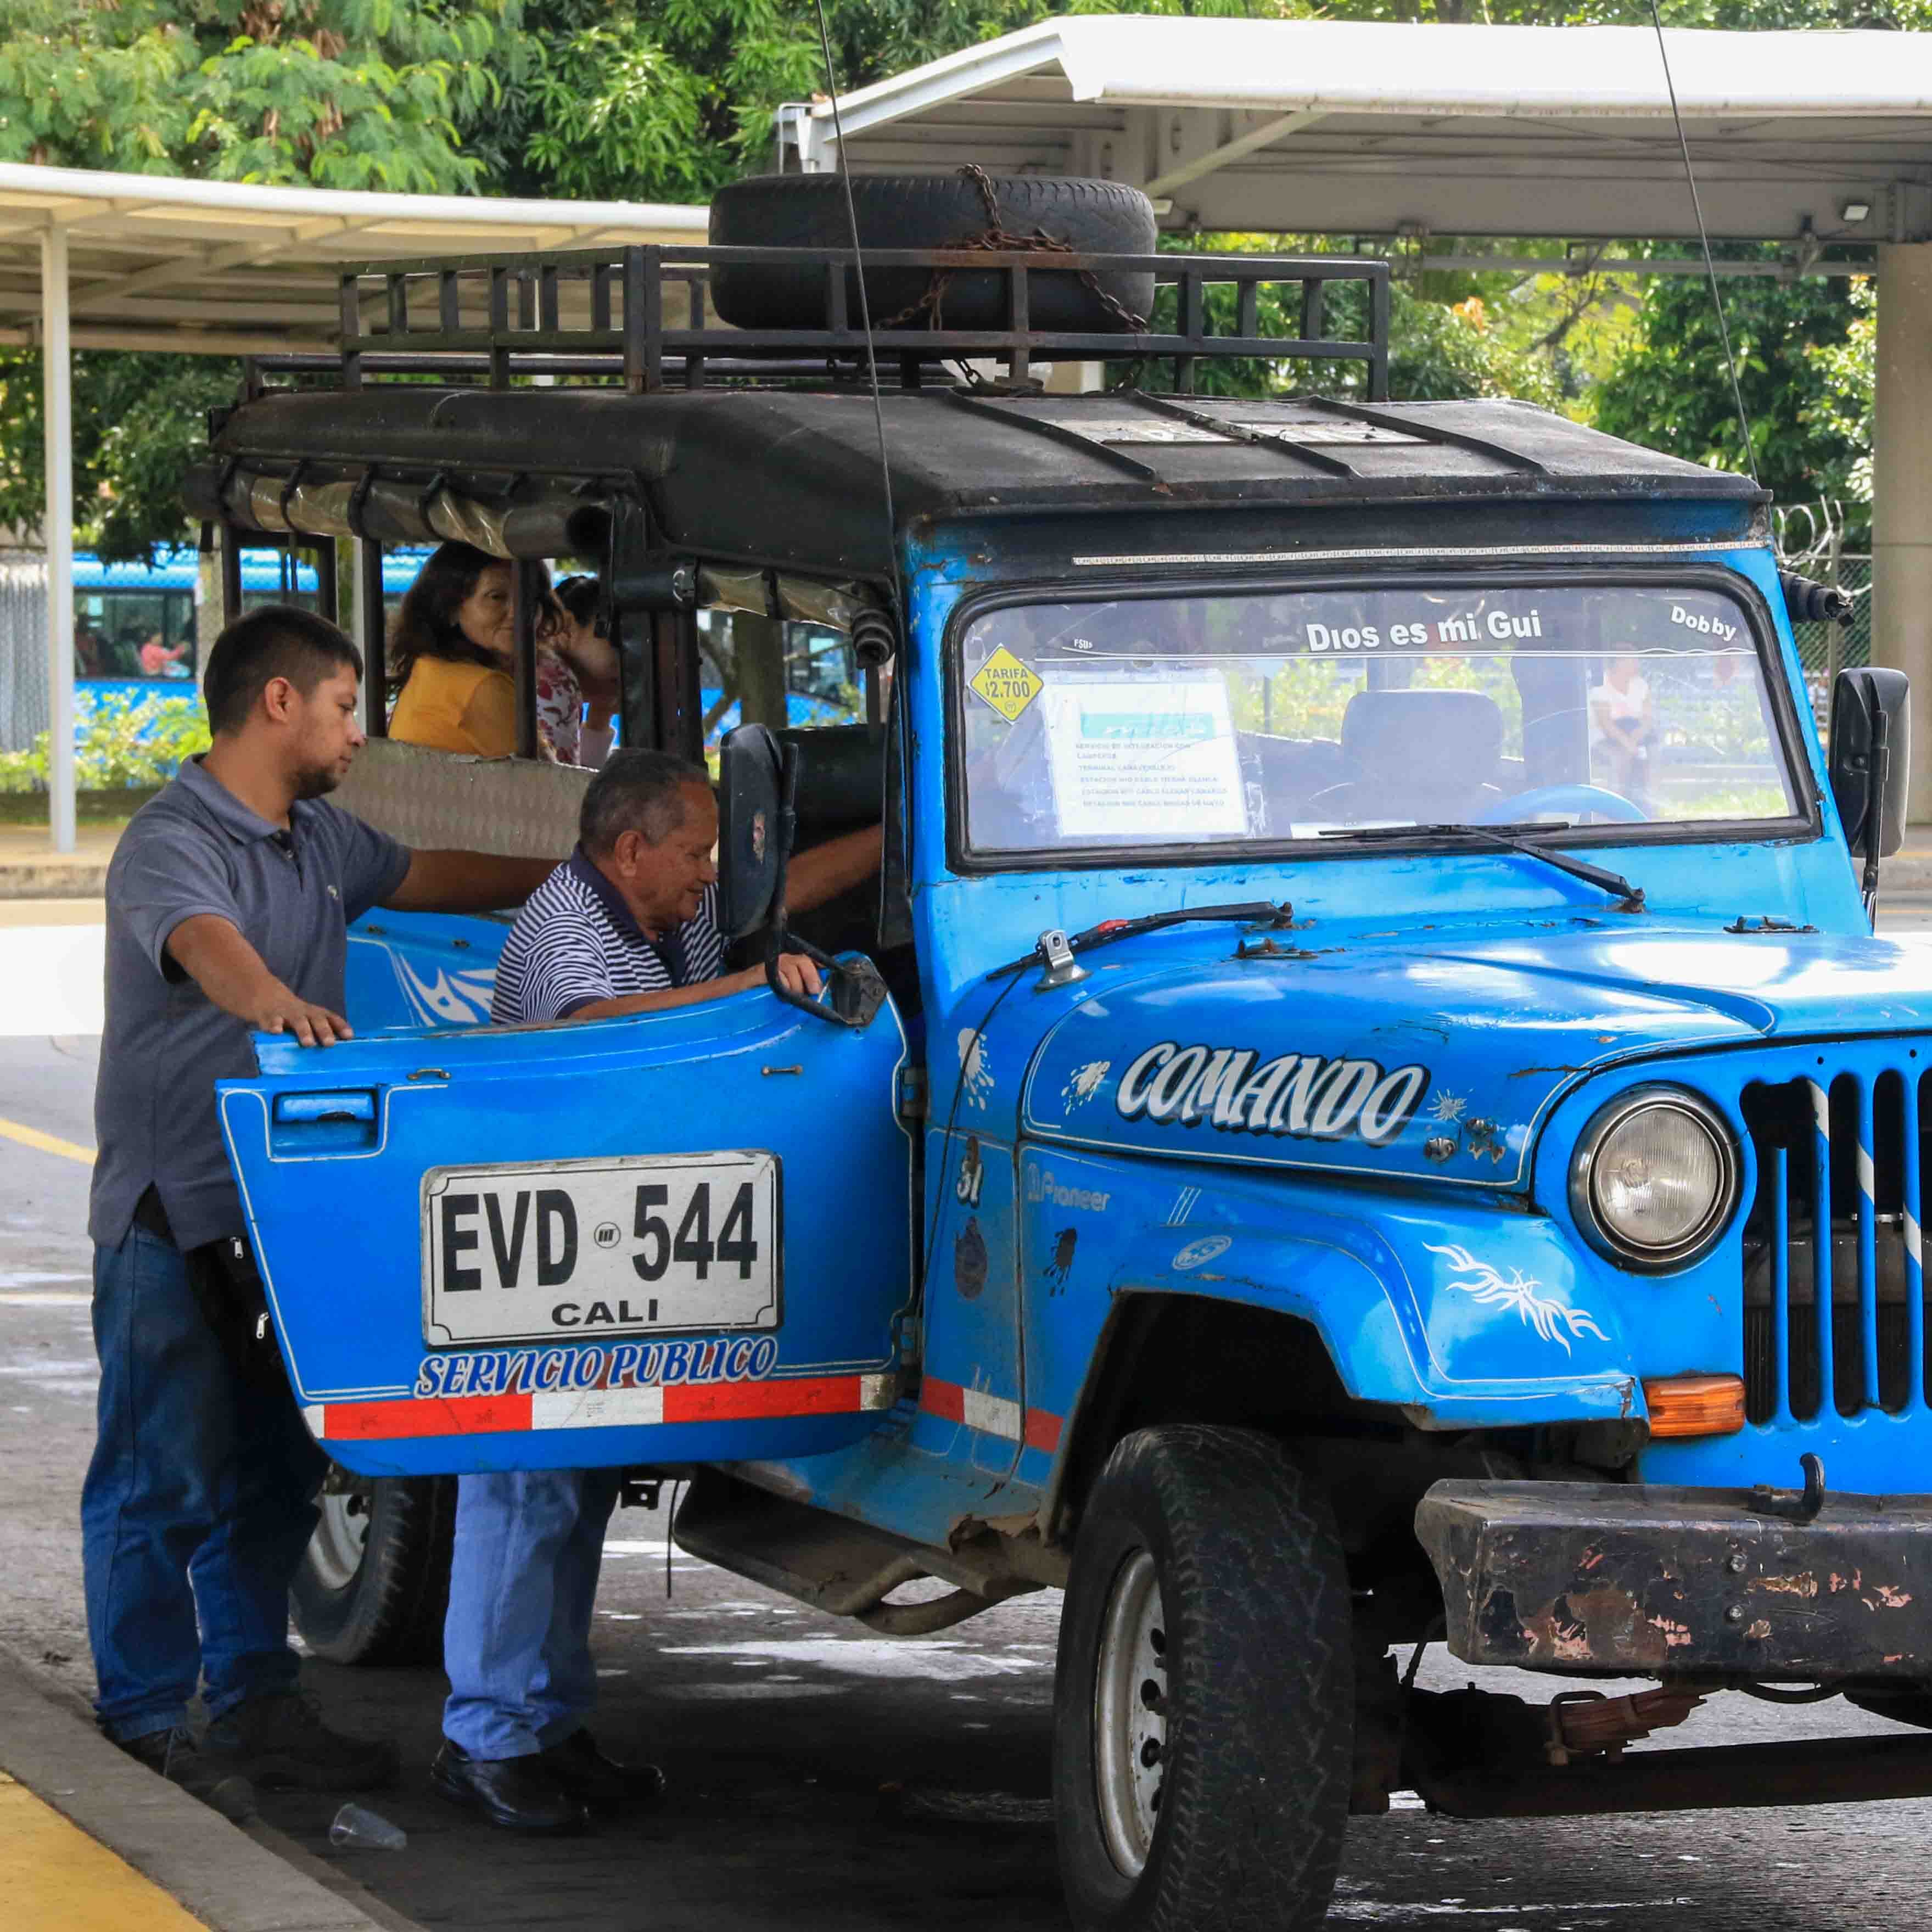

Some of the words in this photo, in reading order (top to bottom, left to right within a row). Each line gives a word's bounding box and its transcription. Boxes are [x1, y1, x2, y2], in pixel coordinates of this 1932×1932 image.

[1306, 623, 1380, 652] Dios
[1389, 623, 1428, 646] es
[1436, 612, 1478, 642] mi
[1487, 609, 1542, 639] Gui
[1671, 606, 1737, 642] Dobby
[984, 668, 1028, 679] TARIFA
[1116, 1041, 1430, 1144] COMANDO
[1042, 1171, 1110, 1212] Pioneer
[441, 1188, 578, 1292] EVD
[631, 1181, 758, 1283] 544
[551, 1299, 658, 1327] CALI
[417, 1345, 603, 1398] SERVICIO
[607, 1336, 778, 1391] PUBLICO
